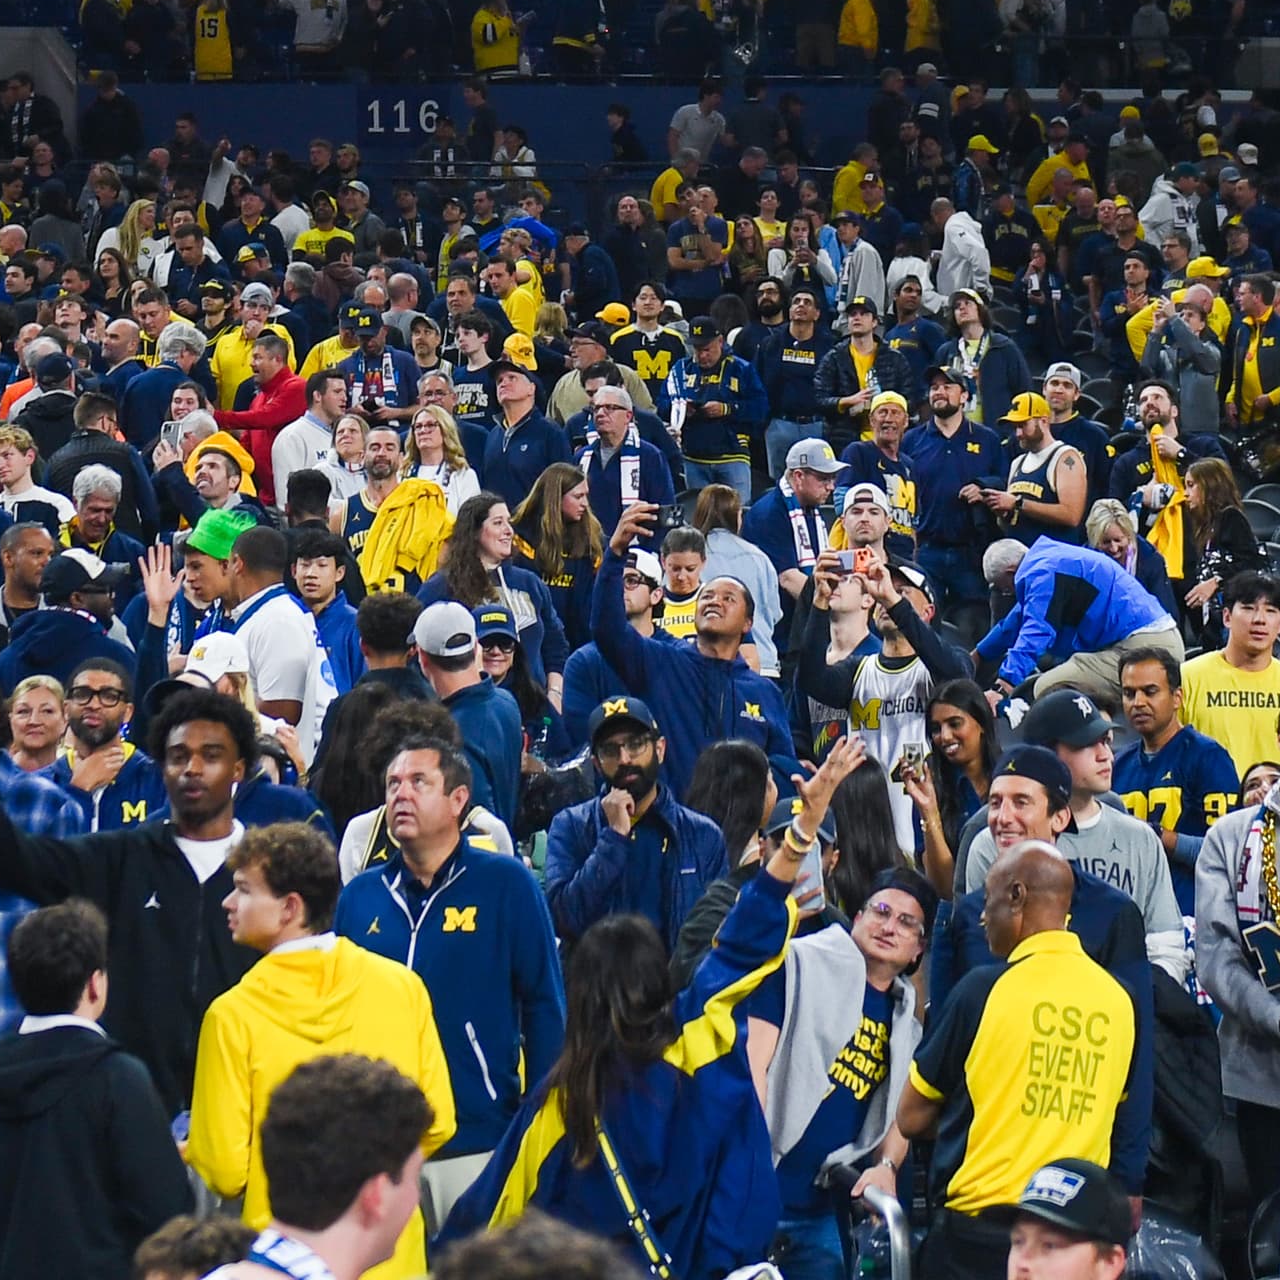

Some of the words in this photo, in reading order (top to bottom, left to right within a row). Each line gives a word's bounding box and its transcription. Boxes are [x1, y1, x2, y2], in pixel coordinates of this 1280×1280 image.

[199, 17, 218, 39] 15
[367, 100, 439, 133] 116
[631, 349, 674, 381] M
[602, 697, 629, 719] M
[121, 799, 147, 824] M
[441, 906, 478, 933] M
[1032, 1001, 1110, 1047] CSC
[1027, 1041, 1105, 1088] EVENT
[1020, 1083, 1096, 1129] STAFF
